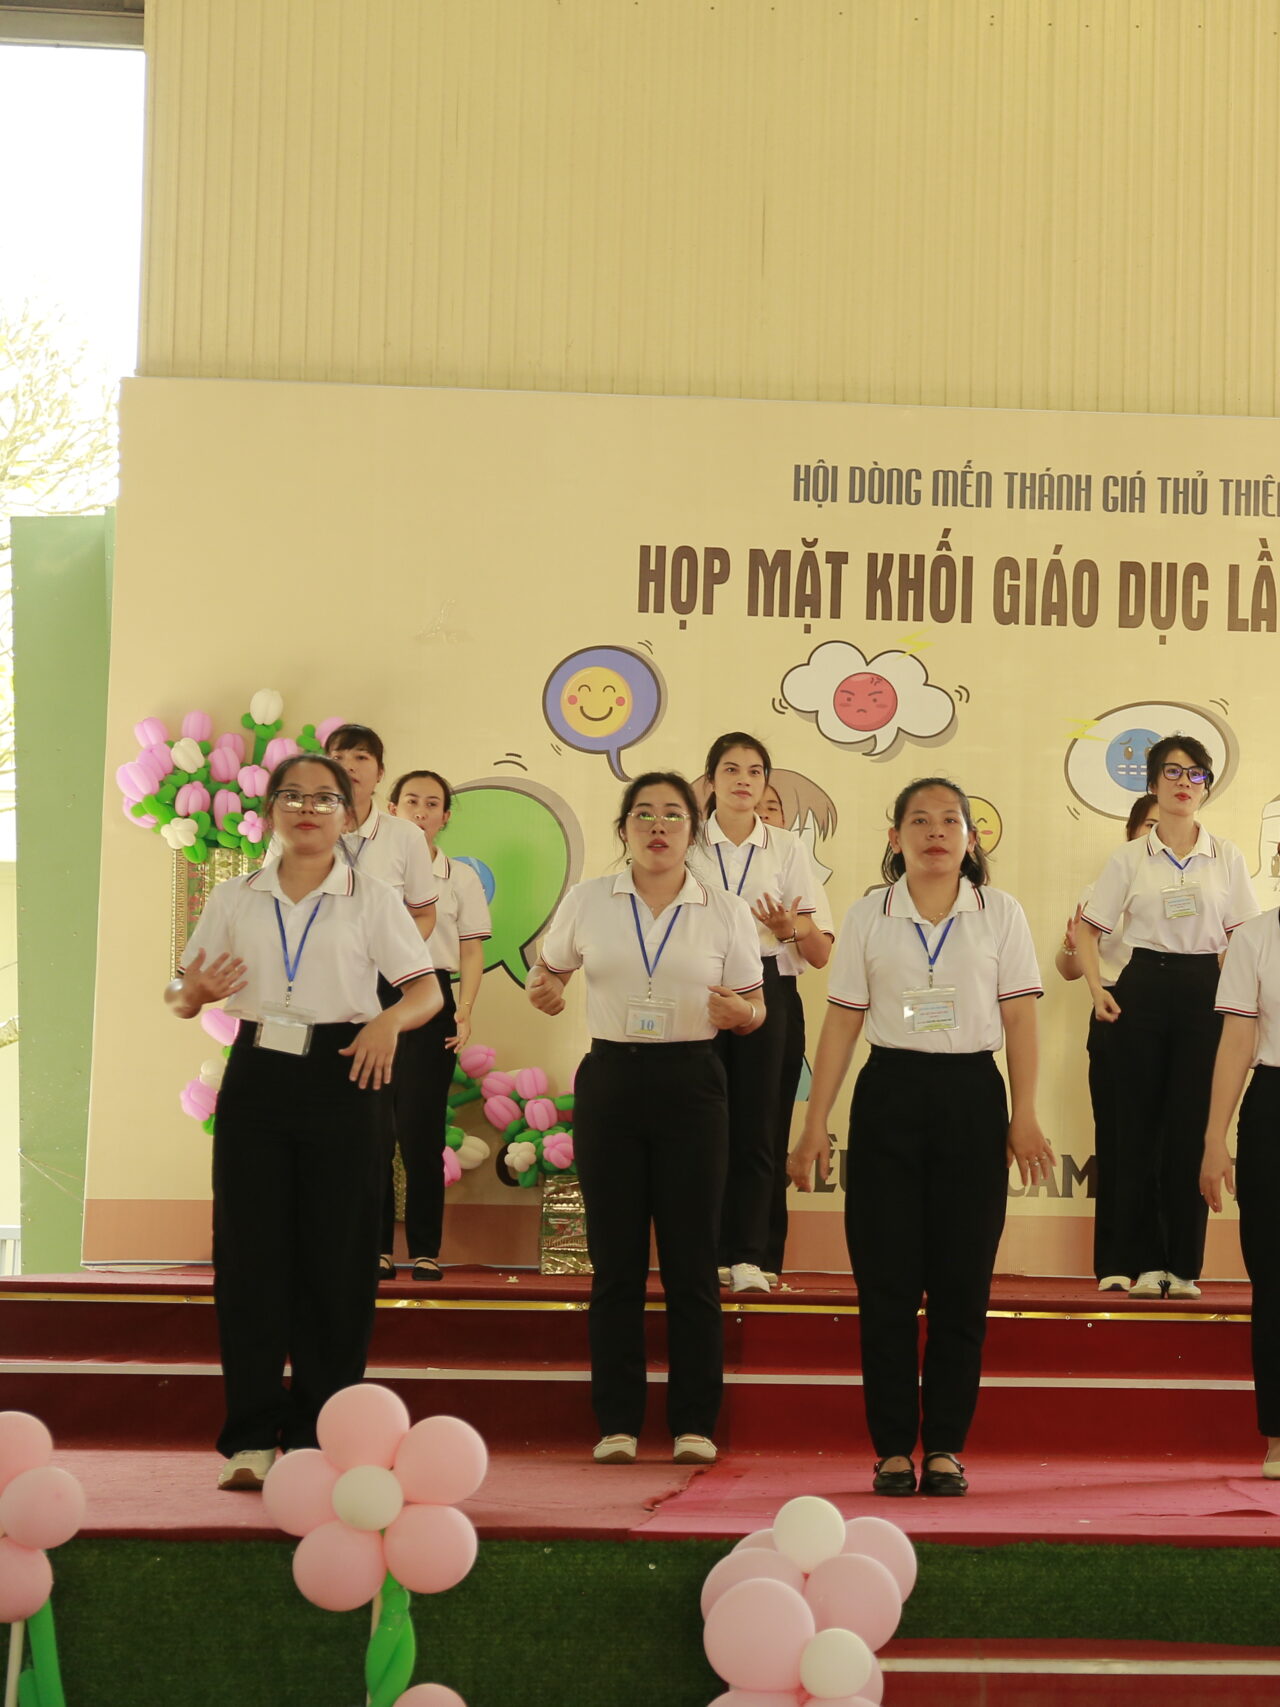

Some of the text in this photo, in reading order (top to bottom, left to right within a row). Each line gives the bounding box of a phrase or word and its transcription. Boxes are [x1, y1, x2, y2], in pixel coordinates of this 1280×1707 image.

[793, 458, 839, 509] HỘI
[848, 460, 922, 506] DÒNG
[931, 459, 993, 509] MẾN
[1003, 466, 1092, 512] THÁNH
[1102, 470, 1146, 514] GIÁ
[1156, 470, 1209, 516] THỦ
[637, 544, 731, 631] HỌP
[747, 537, 849, 636] MẶT
[865, 528, 974, 625] KHỐI
[992, 543, 1101, 630] GIÁO
[1118, 560, 1209, 647] DỤC
[640, 1019, 655, 1032] 10
